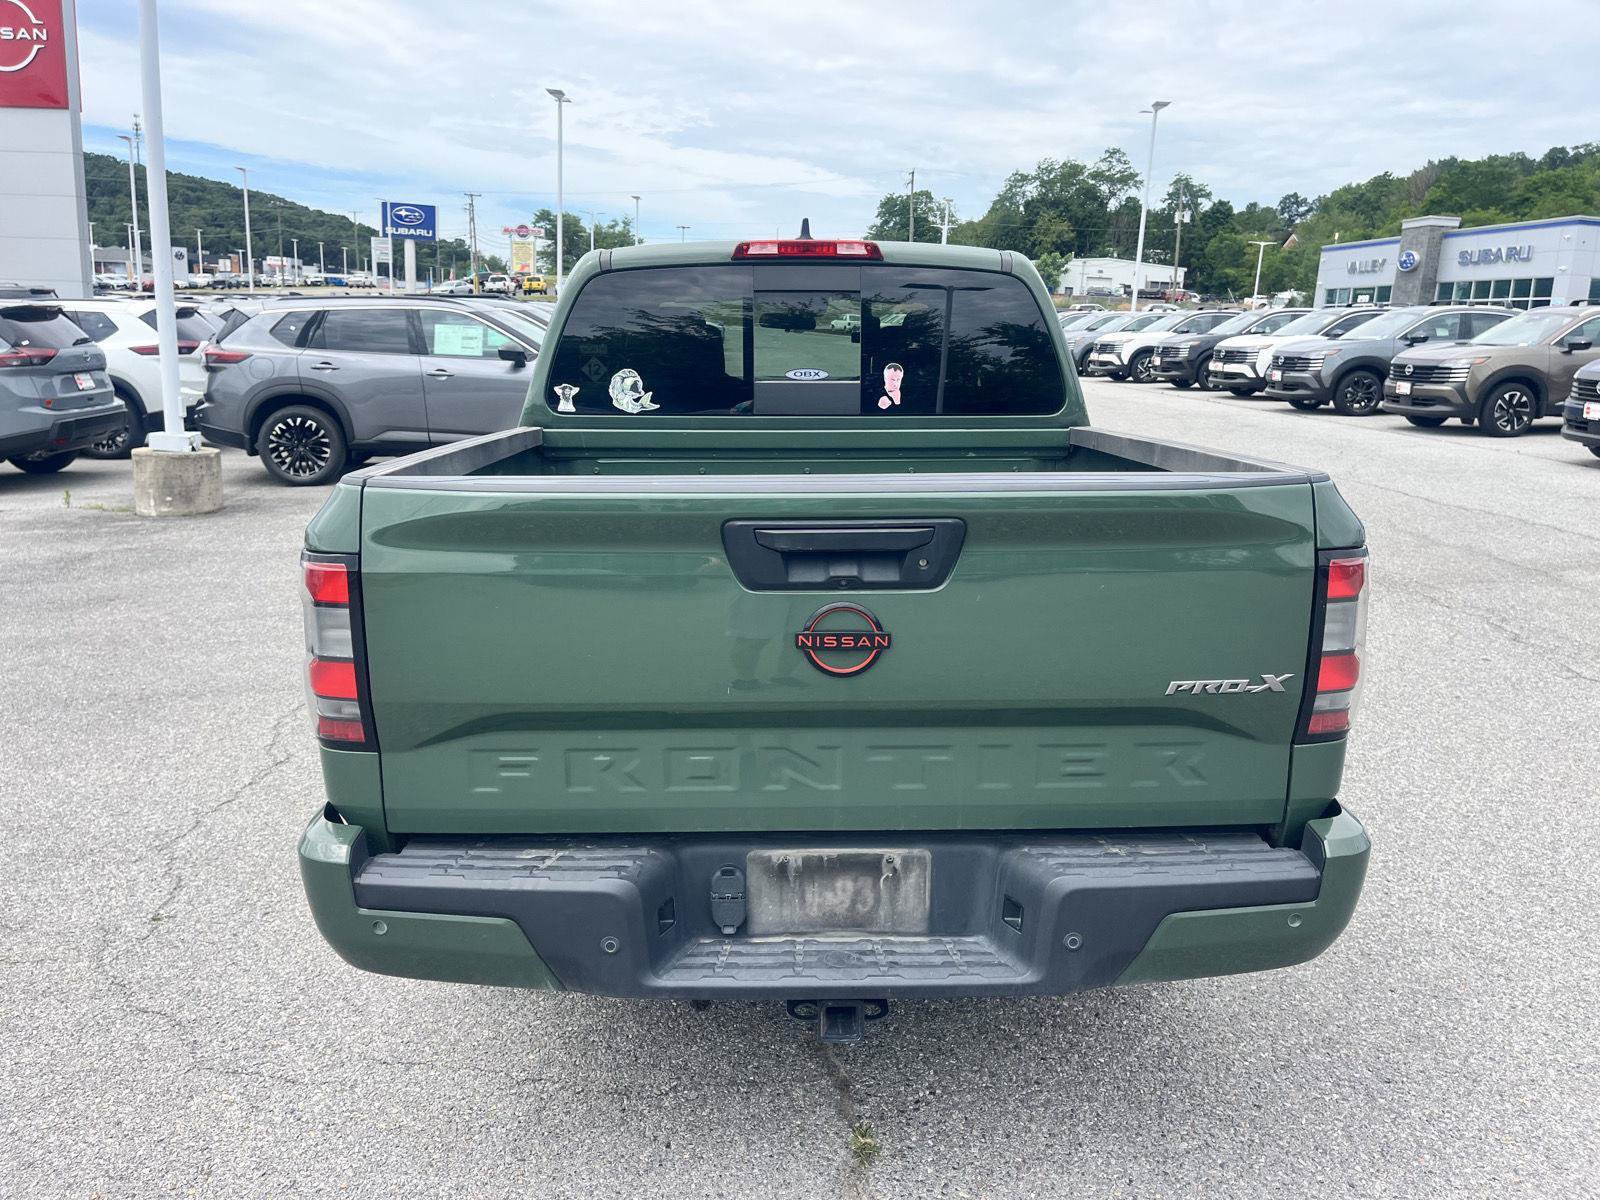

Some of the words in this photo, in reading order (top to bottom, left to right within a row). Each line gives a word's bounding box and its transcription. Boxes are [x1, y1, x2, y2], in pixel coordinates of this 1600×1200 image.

[385, 226, 433, 237] SUBARU
[1457, 245, 1534, 266] SUBARU
[1346, 257, 1387, 274] VALLEY
[798, 635, 889, 647] NISSAN
[467, 742, 1209, 793] FRONTIER
